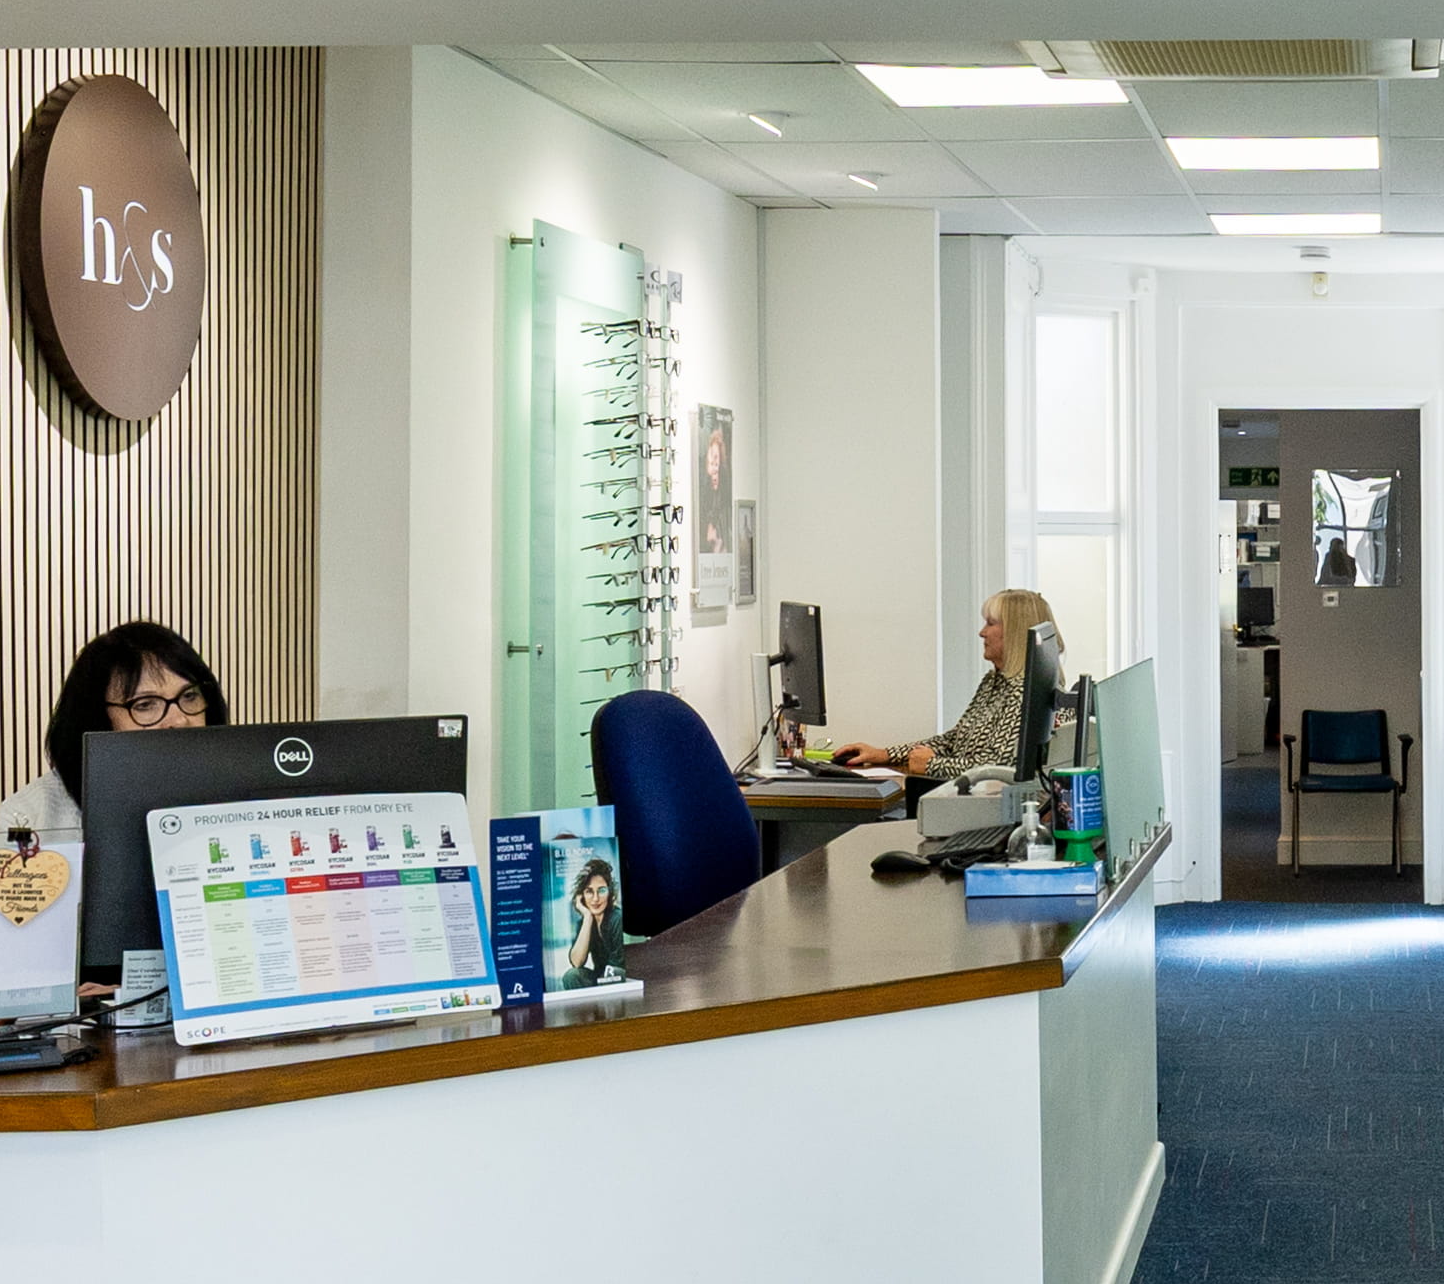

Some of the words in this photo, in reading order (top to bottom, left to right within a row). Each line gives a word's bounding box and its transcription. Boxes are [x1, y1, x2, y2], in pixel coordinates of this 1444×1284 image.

[278, 751, 309, 763] DELL
[194, 811, 255, 826] PROVIDING
[256, 810, 270, 820] 24
[272, 807, 303, 819] HOUR
[305, 805, 341, 818] RELIEF
[343, 804, 372, 815] FROM
[374, 803, 394, 813] DRY
[395, 802, 414, 813] EYE
[186, 1025, 227, 1040] SCOPE
